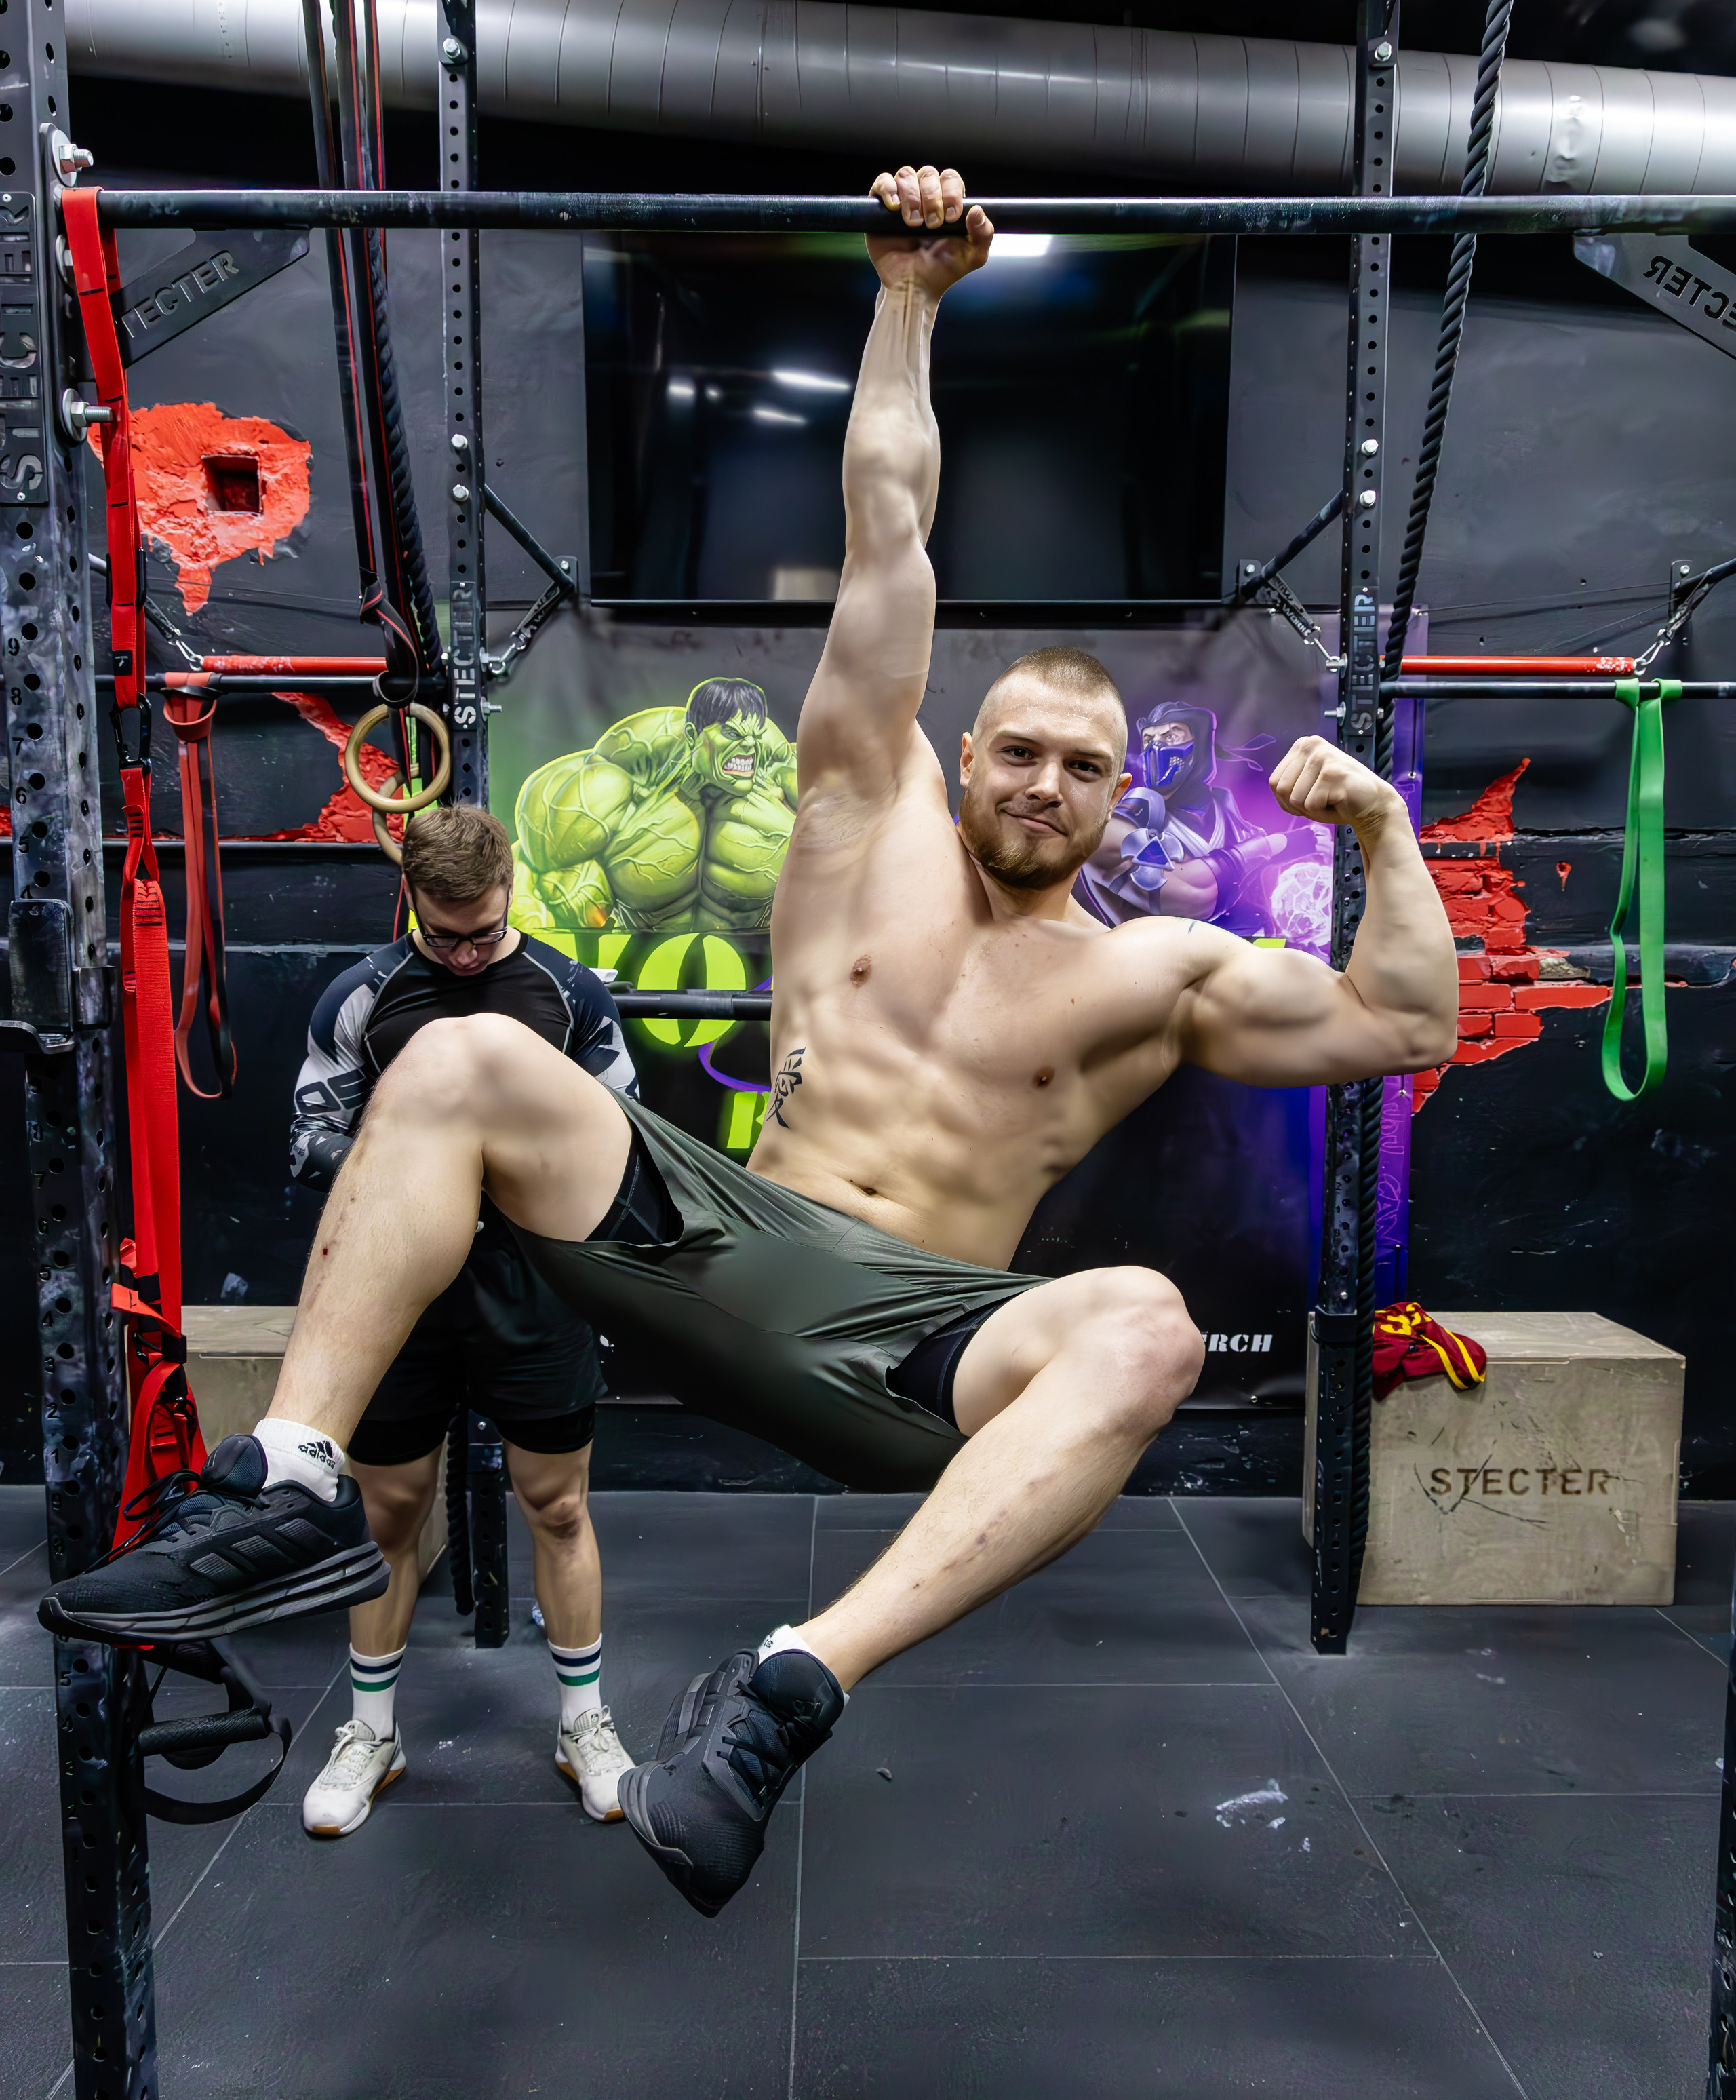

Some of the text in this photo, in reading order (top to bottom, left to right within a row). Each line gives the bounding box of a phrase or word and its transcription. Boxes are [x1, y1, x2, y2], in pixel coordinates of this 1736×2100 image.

[114, 250, 239, 338] TECTER
[452, 588, 477, 724] STECTER
[1350, 594, 1375, 730] STECTER
[11, 687, 22, 706] 8
[12, 737, 24, 756] 7
[16, 787, 27, 805] 6
[18, 836, 30, 854] 5
[46, 1402, 58, 1419] 2
[50, 1448, 59, 1465] 1
[298, 1444, 336, 1470] adidas
[1429, 1467, 1609, 1496] STECTER
